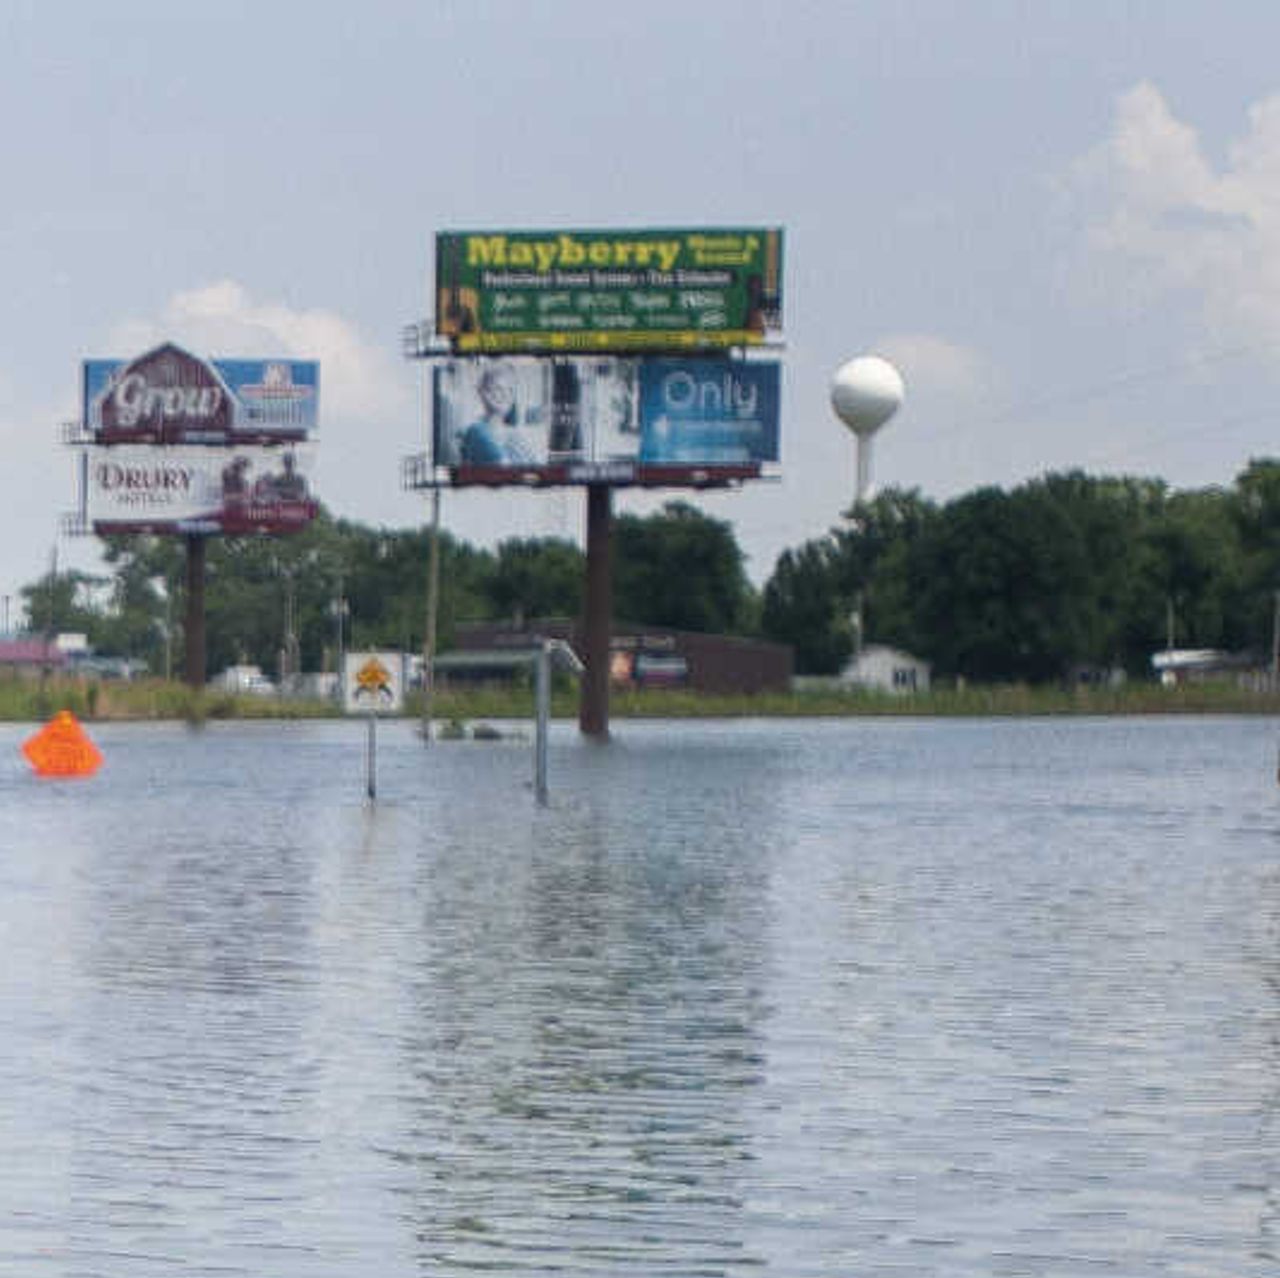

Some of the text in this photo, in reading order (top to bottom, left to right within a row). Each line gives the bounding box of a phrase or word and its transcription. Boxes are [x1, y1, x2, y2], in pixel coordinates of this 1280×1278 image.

[467, 235, 680, 271] Mayberry
[665, 371, 758, 416] Only
[98, 463, 191, 489] DRURY
